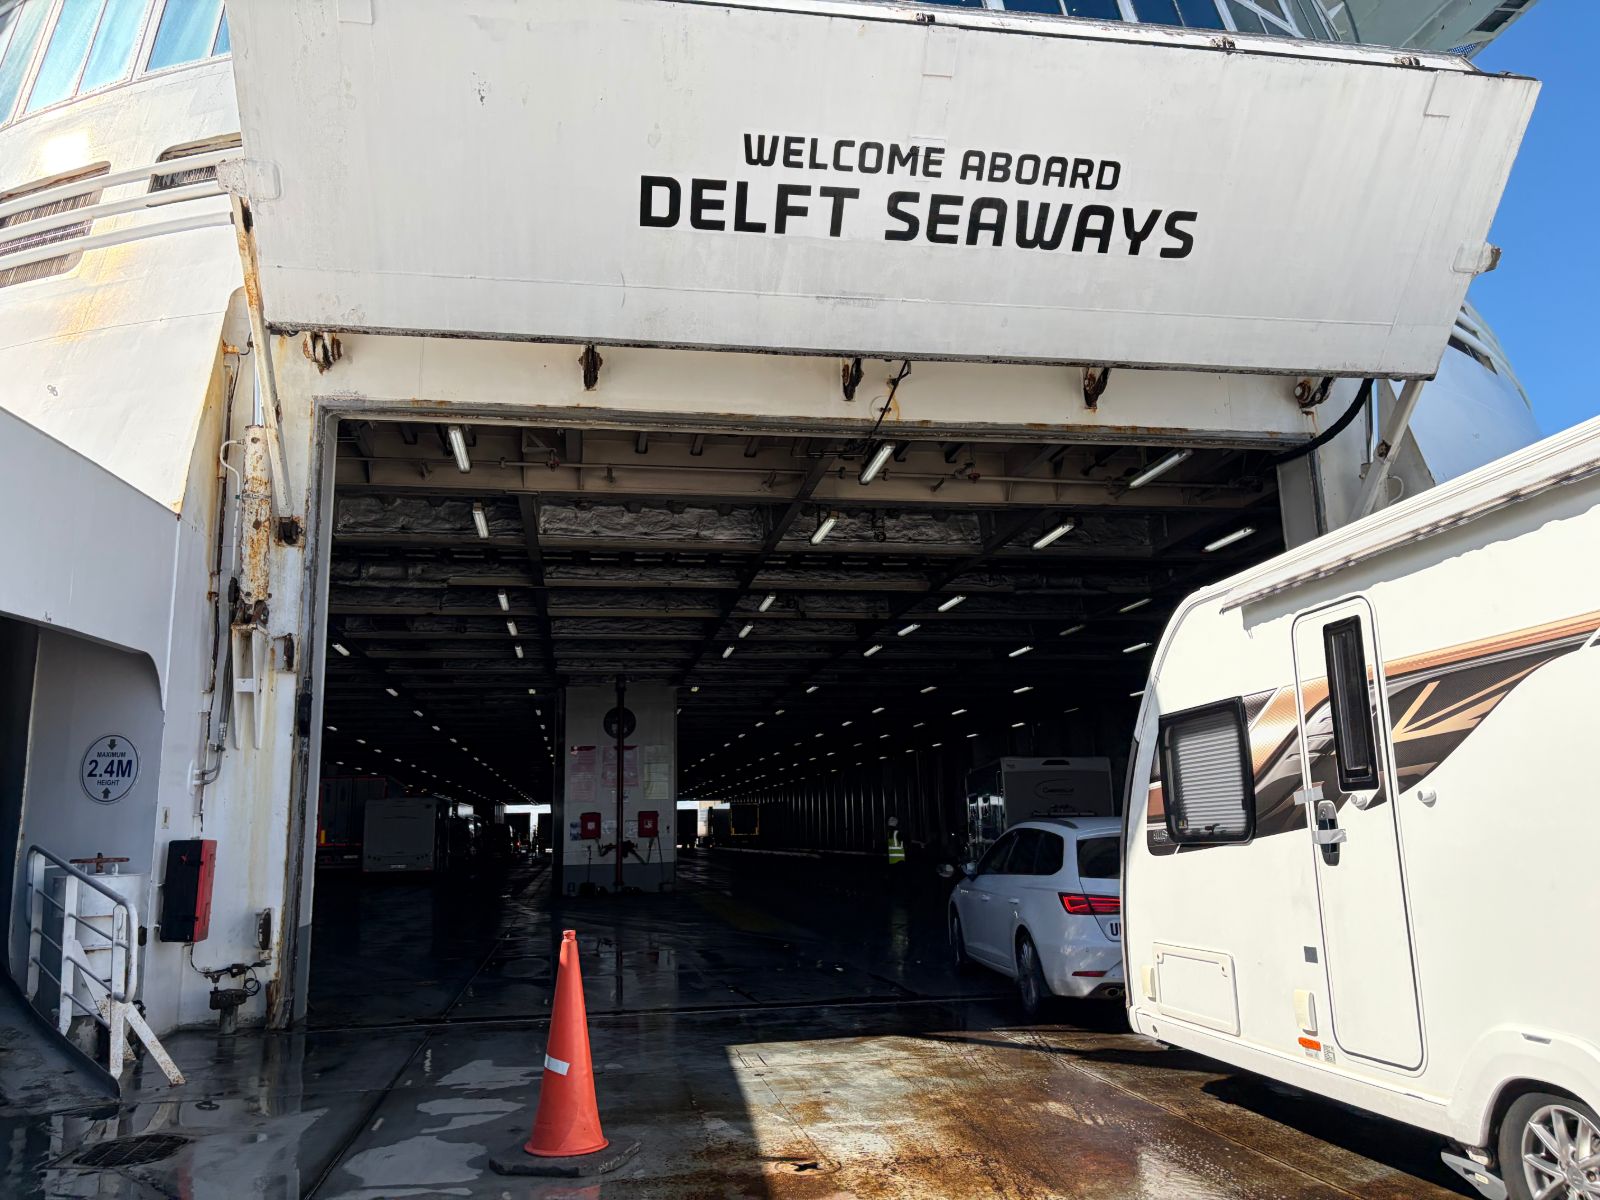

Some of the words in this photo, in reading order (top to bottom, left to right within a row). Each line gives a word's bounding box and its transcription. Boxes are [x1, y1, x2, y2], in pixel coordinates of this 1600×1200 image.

[744, 133, 945, 178] WELCOME
[960, 150, 1121, 191] ABOARD
[639, 175, 860, 238] DELFT
[884, 191, 1198, 259] SEAWAYS
[87, 759, 133, 778] 2.4M
